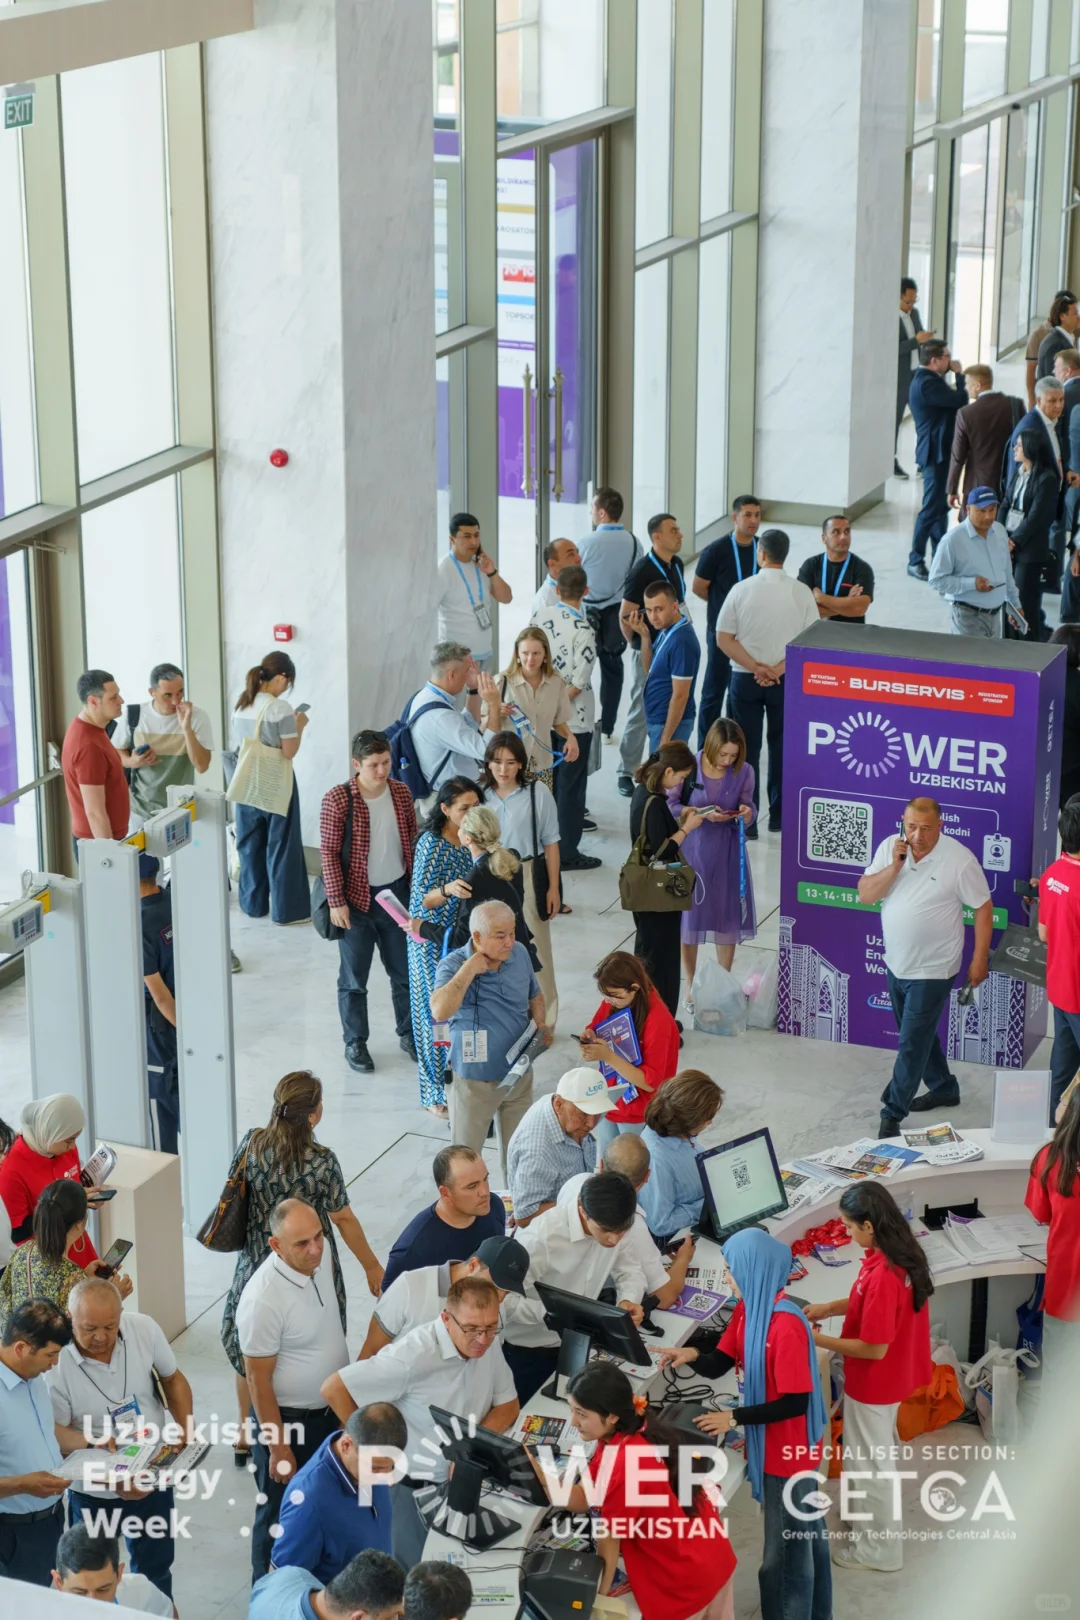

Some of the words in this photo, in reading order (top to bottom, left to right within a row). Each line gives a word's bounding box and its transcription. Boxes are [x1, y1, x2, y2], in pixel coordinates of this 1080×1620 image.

[6, 99, 32, 124] EXIT
[849, 677, 965, 701] BURSERVIS
[808, 711, 1007, 778] POWER
[910, 772, 1006, 794] UZBEKISTAN
[944, 826, 970, 837] kodni
[790, 1194, 805, 1208] EXPO
